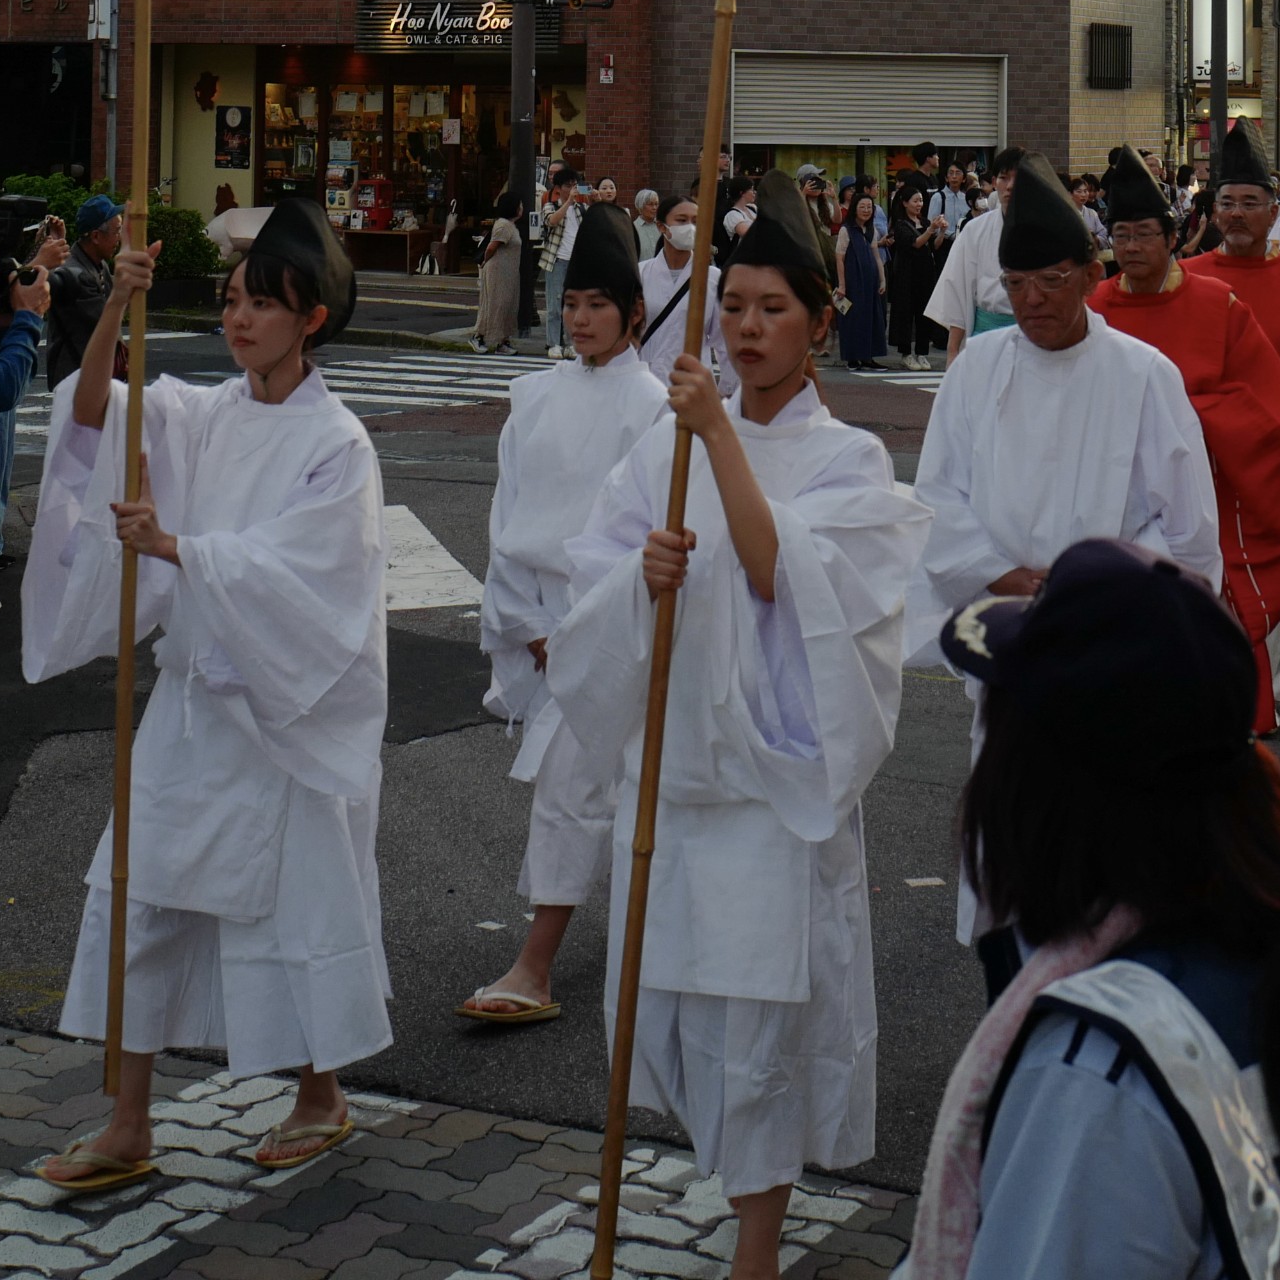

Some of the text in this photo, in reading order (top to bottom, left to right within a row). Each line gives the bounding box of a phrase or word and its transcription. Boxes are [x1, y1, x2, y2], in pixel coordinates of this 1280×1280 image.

[389, 1, 514, 36] Hoo Nyan Boo
[405, 34, 503, 45] OWL & CAT & PIG
